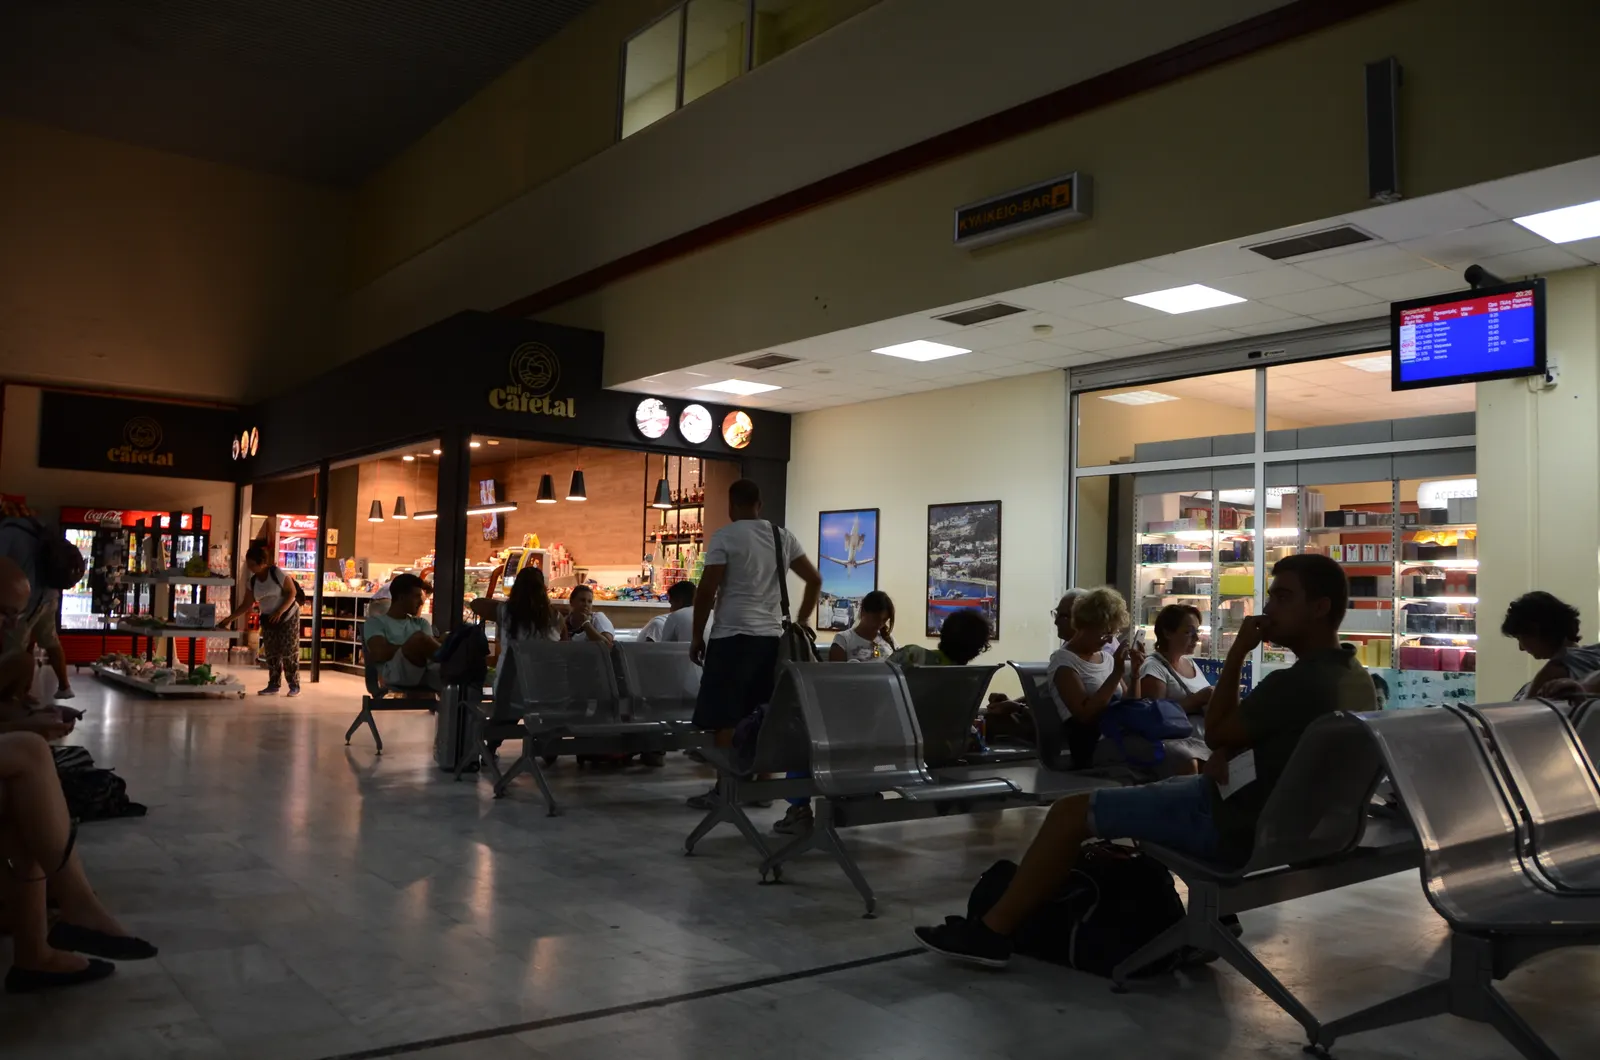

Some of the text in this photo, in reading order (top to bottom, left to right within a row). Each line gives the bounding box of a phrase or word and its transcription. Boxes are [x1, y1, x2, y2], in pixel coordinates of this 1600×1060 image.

[506, 384, 522, 395] mi
[488, 388, 577, 418] Cafetal
[106, 447, 174, 467] Cafetal
